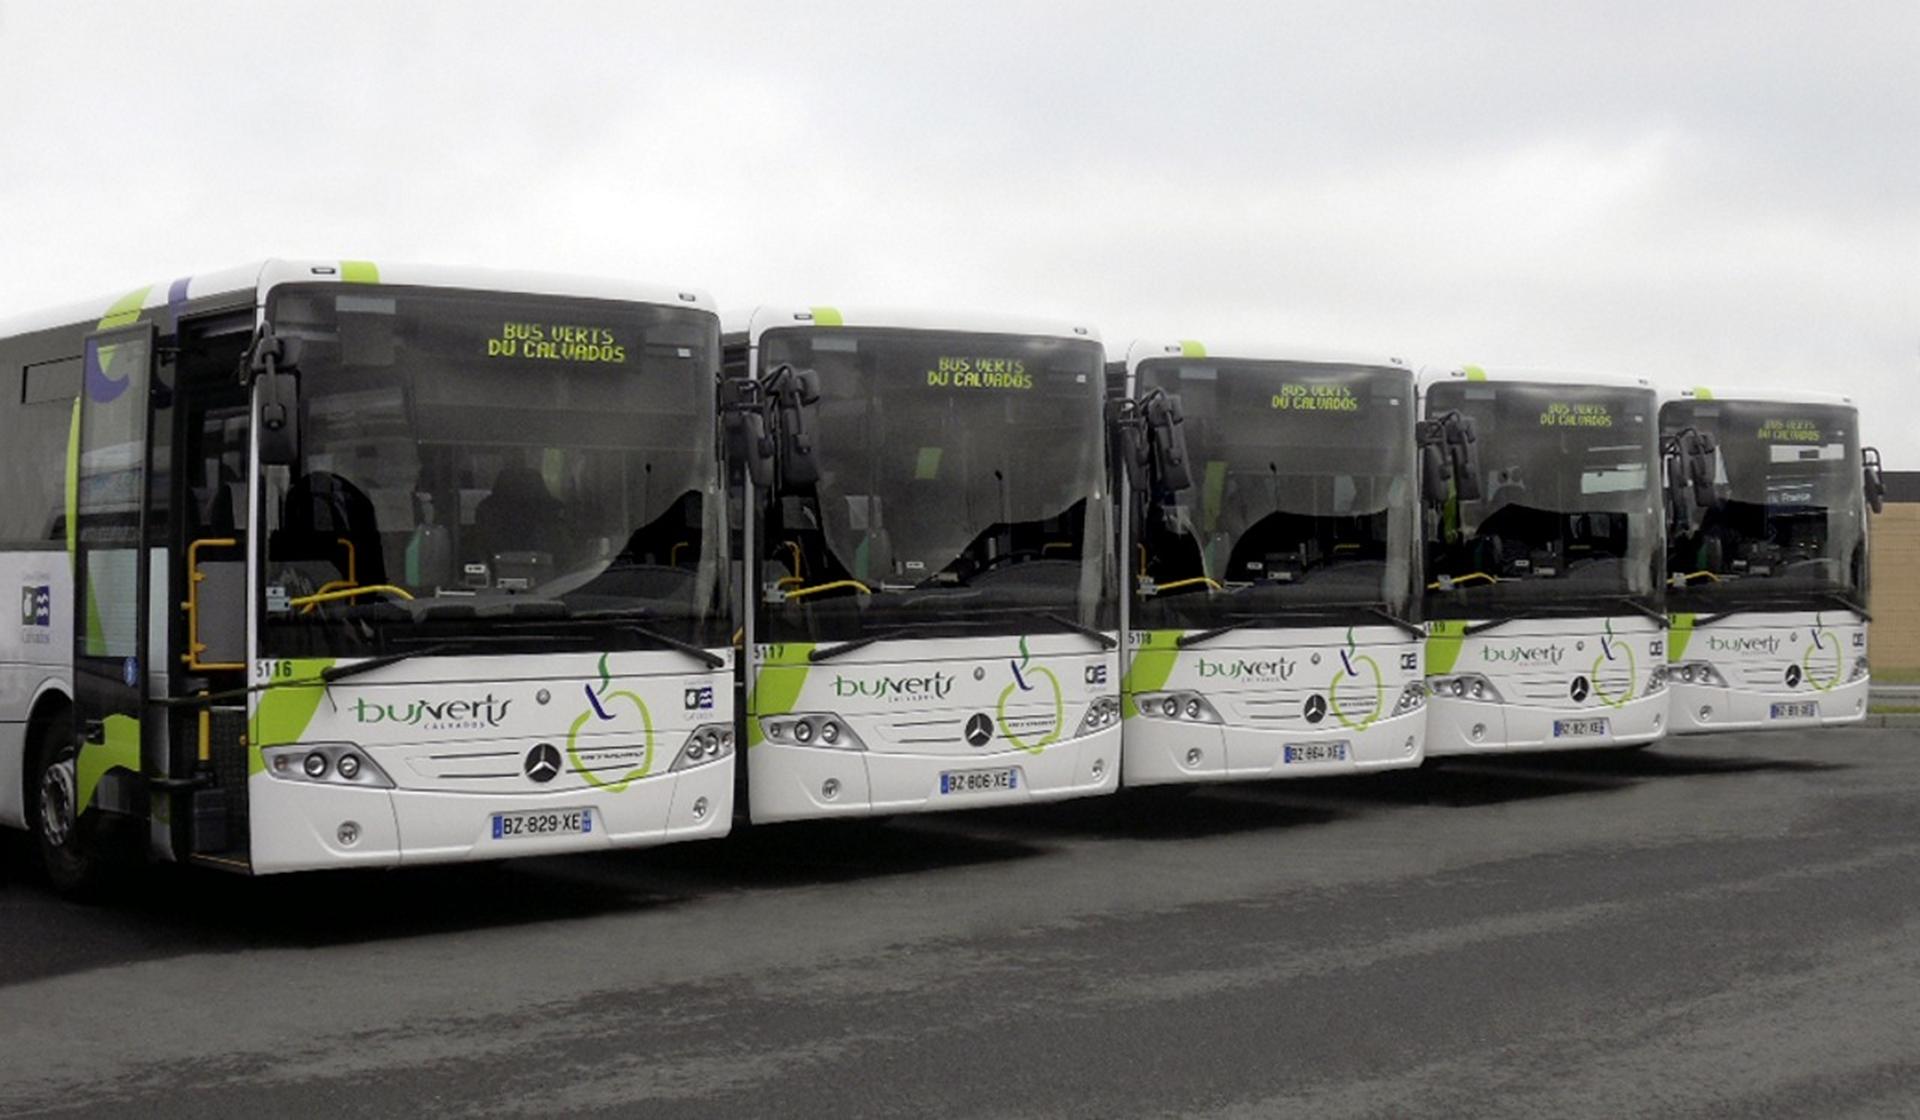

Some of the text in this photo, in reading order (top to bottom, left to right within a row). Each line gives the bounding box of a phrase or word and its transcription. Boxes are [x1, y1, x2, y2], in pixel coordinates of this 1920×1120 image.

[503, 323, 614, 345] BUS VERTS
[488, 339, 625, 363] DU CALVADOS
[939, 356, 1025, 374] BUS VERTS
[927, 370, 1033, 389] DU CALVADOS
[754, 645, 784, 660] 5117
[256, 661, 292, 677] 5116
[503, 813, 581, 835] BZ-829-XE
